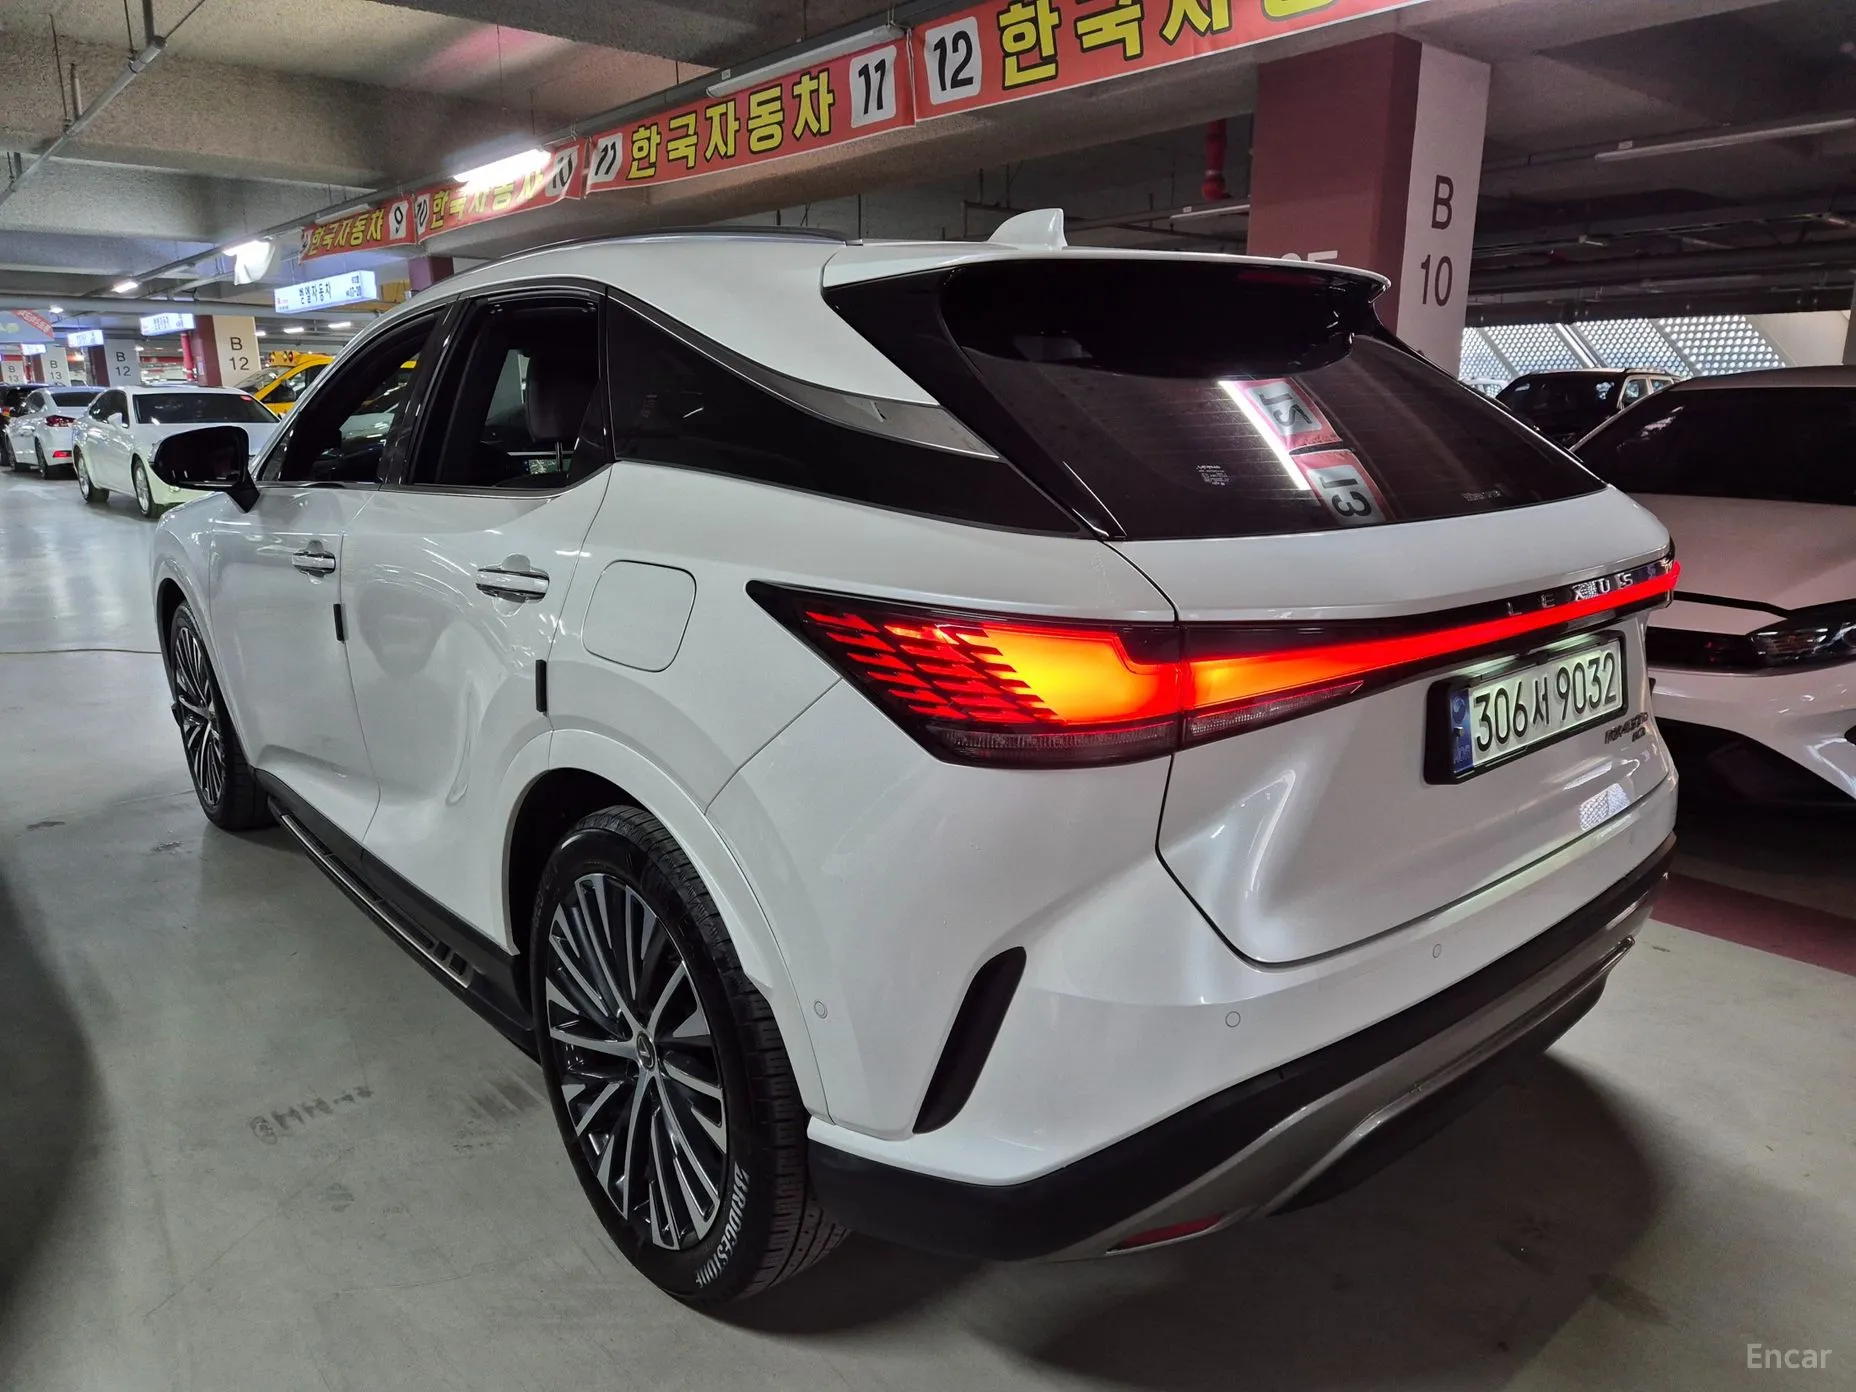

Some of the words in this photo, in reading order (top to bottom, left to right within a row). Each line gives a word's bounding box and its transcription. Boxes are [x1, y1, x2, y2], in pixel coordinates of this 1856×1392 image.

[931, 30, 975, 92] 12
[594, 141, 618, 177] 11
[626, 67, 835, 181] 한국자동차
[857, 58, 887, 116] 11
[1431, 174, 1454, 230] B
[308, 208, 385, 257] 한국자동차
[393, 206, 404, 235] 9
[1420, 253, 1453, 307] 10
[116, 351, 126, 362] B
[230, 336, 243, 351] B
[50, 360, 58, 369] B
[50, 371, 62, 380] 13
[115, 366, 131, 377] 12
[229, 356, 250, 371] 12
[1474, 676, 1550, 752] 306서
[1556, 651, 1617, 721] 9032
